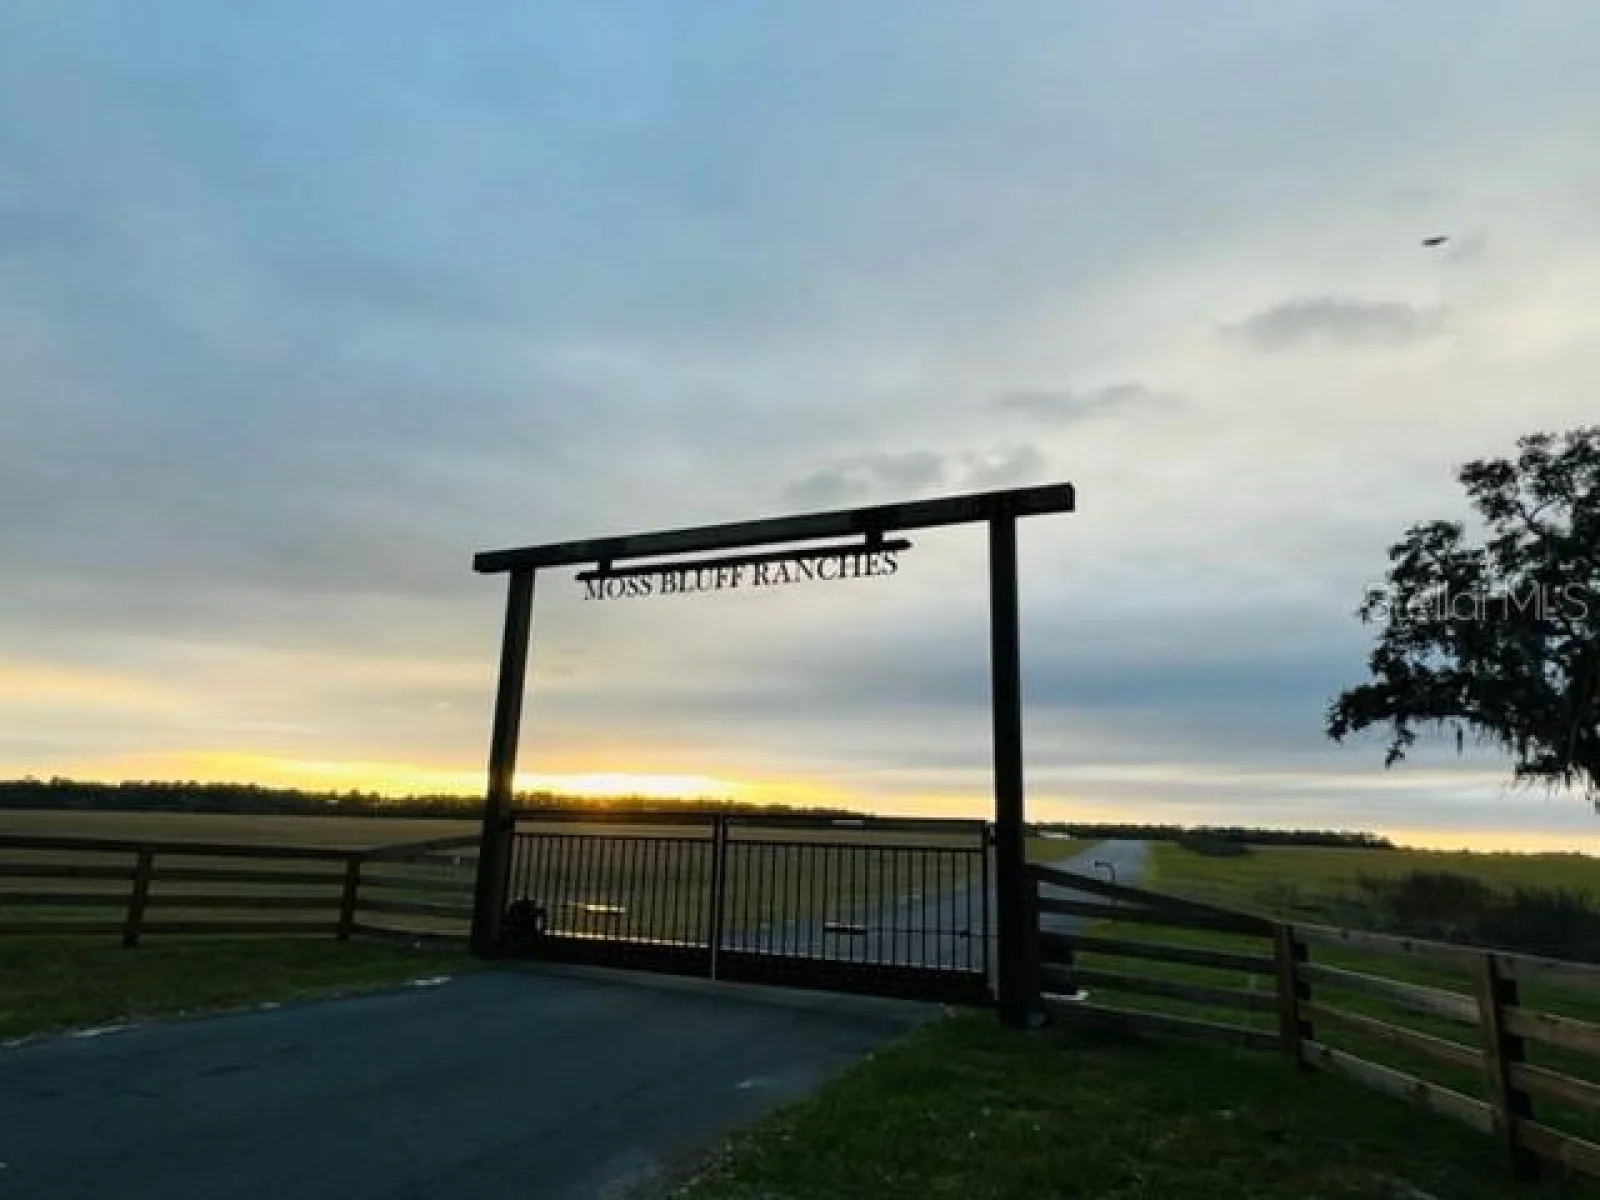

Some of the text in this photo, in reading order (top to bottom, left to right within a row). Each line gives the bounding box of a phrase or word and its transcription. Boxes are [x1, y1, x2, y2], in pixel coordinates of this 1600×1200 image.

[583, 551, 898, 601] MOSS BLUFF RANCHES
